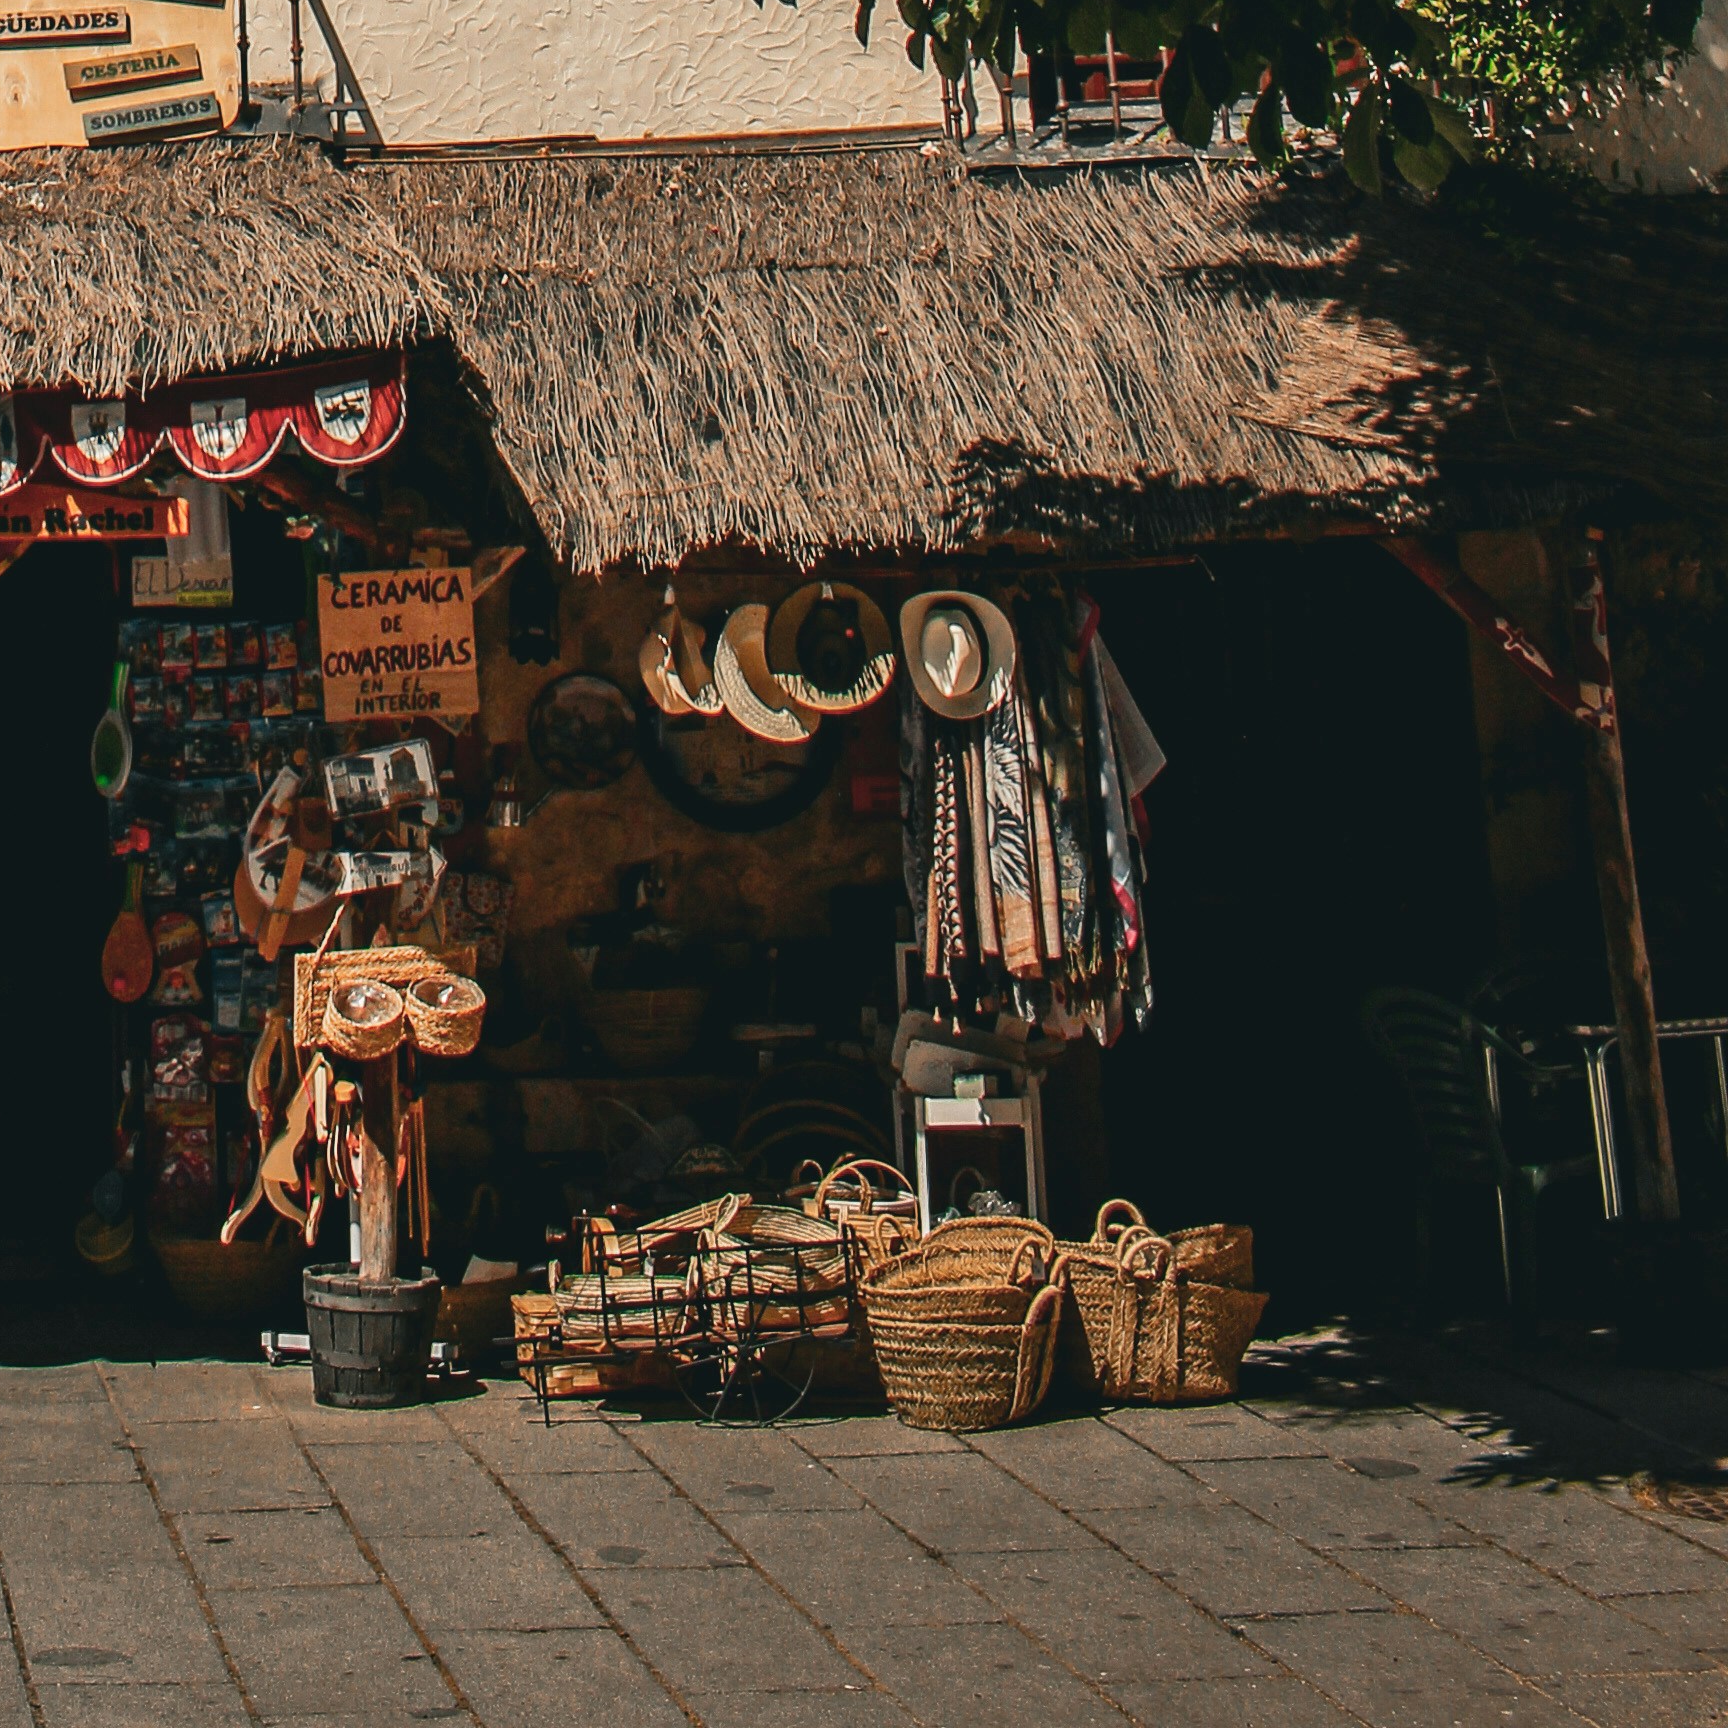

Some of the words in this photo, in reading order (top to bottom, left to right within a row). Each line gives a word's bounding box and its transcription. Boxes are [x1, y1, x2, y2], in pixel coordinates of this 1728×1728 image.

[90, 98, 211, 130] SOMBREROS
[45, 507, 154, 533] Rachel
[330, 570, 464, 609] CERÁMICA
[380, 615, 402, 633] DE
[360, 678, 383, 694] EN
[401, 677, 424, 693] EL
[355, 692, 441, 715] INTERIOR
